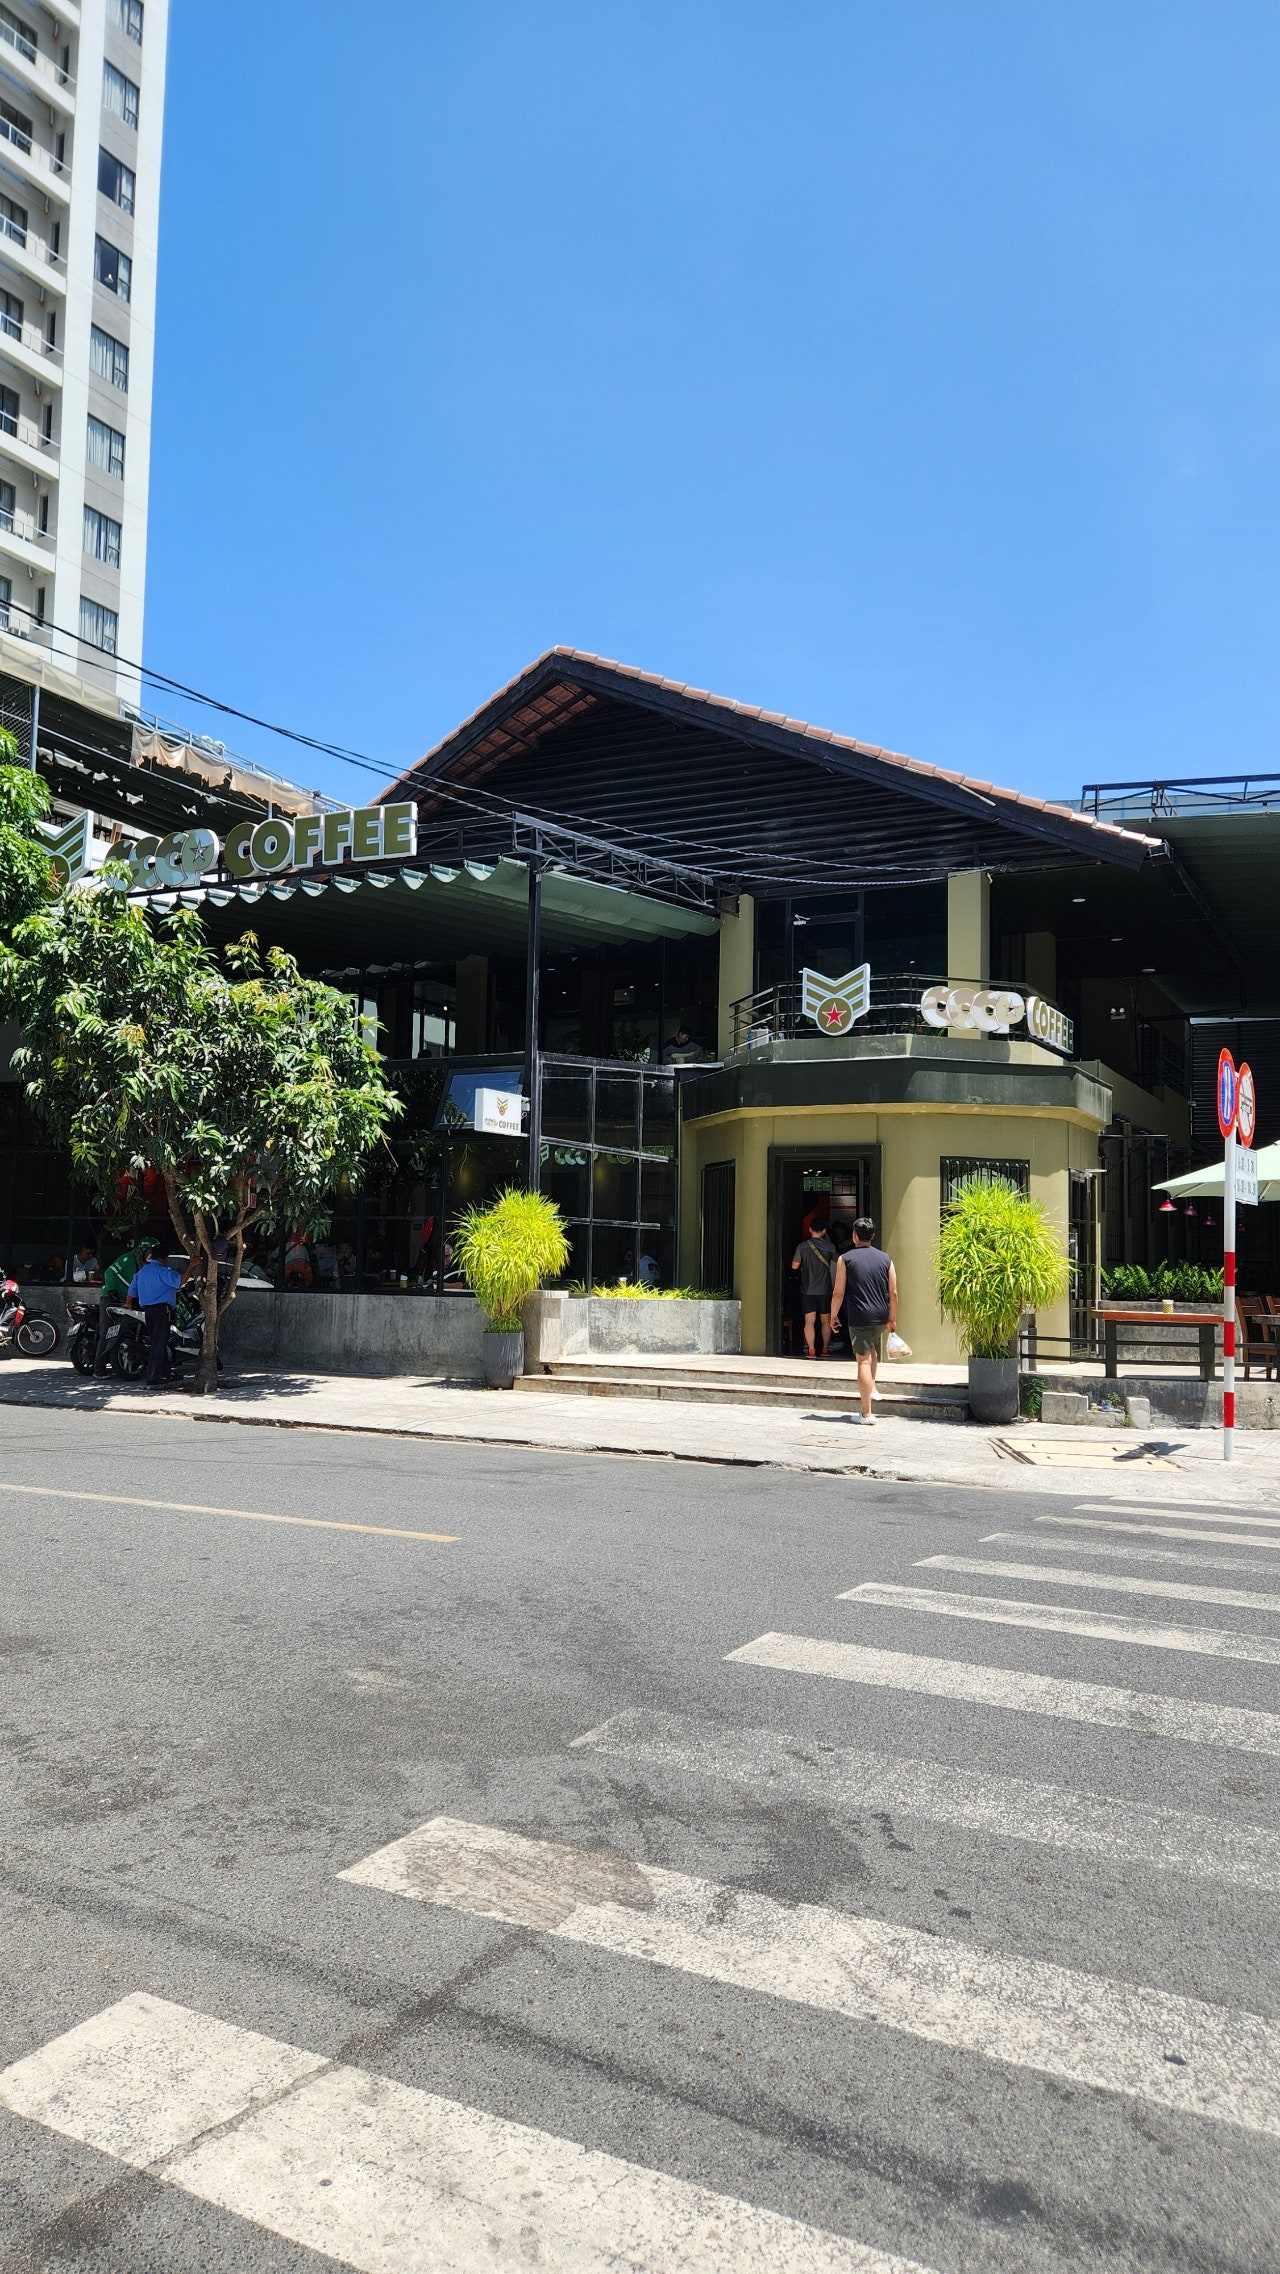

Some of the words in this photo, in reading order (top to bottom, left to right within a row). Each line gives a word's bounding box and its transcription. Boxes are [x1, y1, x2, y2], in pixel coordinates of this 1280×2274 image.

[224, 801, 418, 878] COFFEE
[1027, 996, 1074, 1054] COFFEE
[499, 1120, 520, 1131] COFFEE
